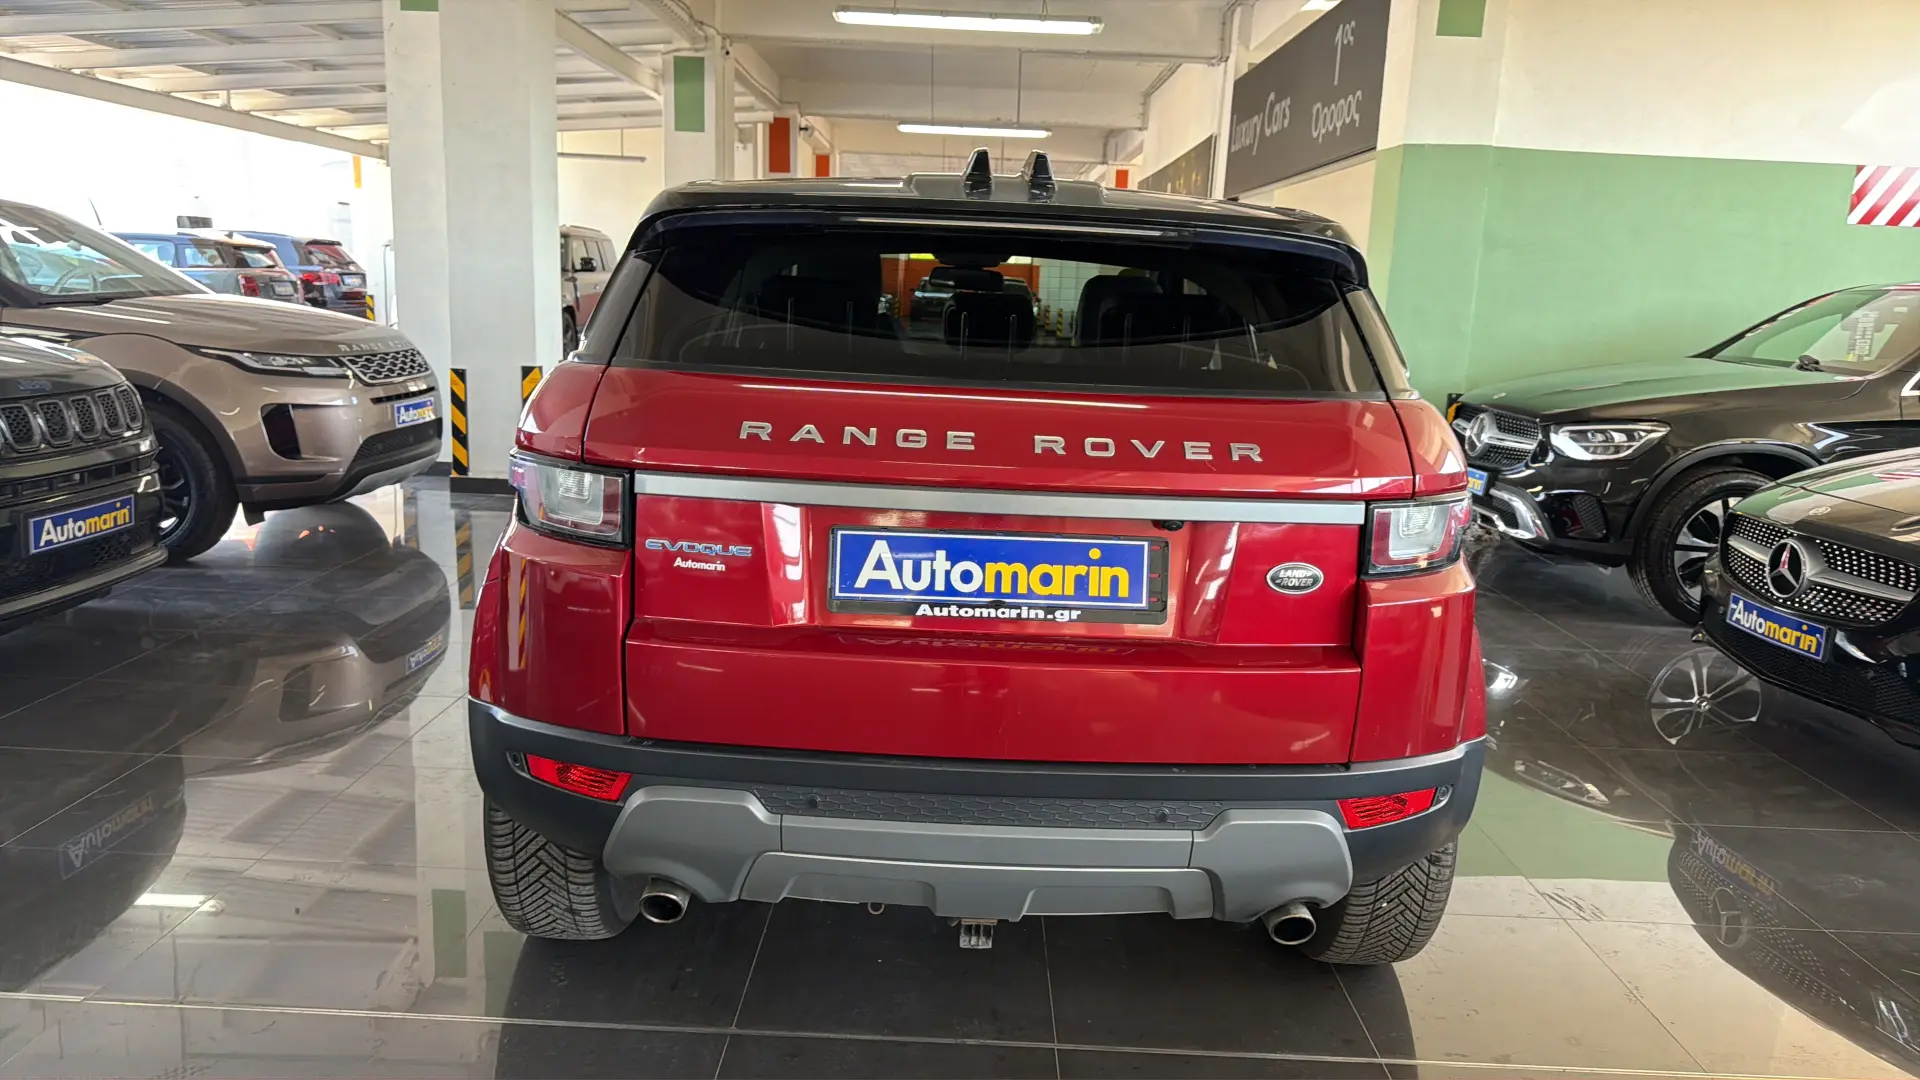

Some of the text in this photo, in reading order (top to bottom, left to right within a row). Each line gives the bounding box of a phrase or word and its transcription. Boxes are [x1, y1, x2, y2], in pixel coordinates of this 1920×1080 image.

[1231, 92, 1291, 155] Luxury Cars
[738, 420, 1263, 462] RANGE ROVER
[39, 501, 130, 547] Automarin
[645, 538, 752, 556] EVOQUE
[673, 557, 726, 571] Automarin
[854, 539, 1129, 598] Automarin
[1279, 569, 1307, 578] LAND
[1280, 578, 1314, 587] ROVER
[915, 603, 1082, 622] Automarin.gr
[1731, 600, 1817, 654] Automarin
